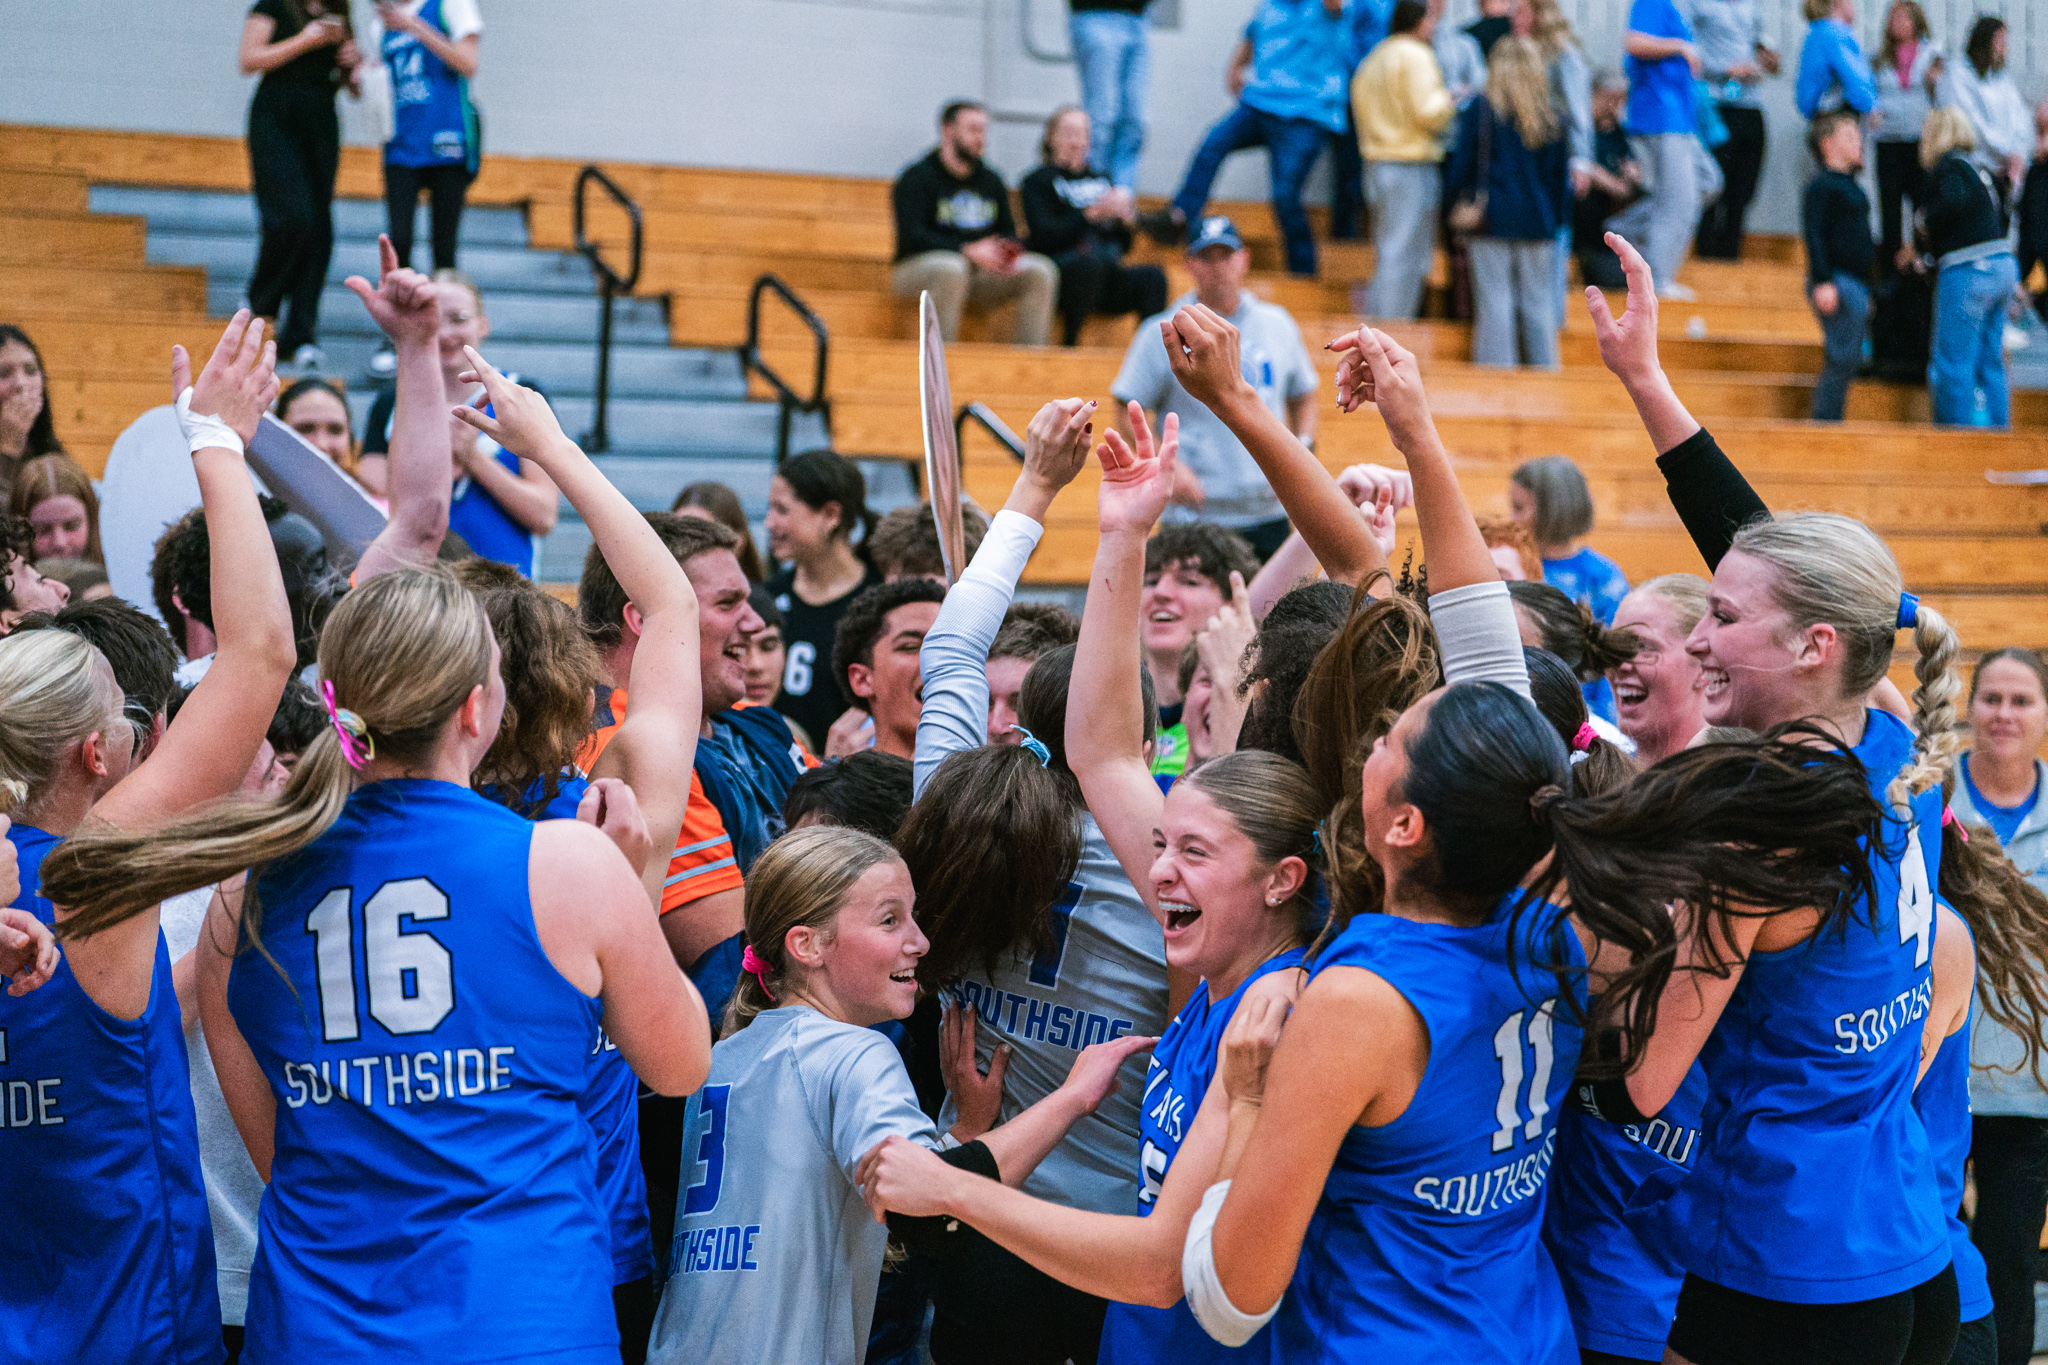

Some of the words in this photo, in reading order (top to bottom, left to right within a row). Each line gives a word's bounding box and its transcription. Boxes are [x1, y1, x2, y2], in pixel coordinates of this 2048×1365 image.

[784, 641, 816, 696] 6
[305, 876, 456, 1043] 16
[1898, 823, 1933, 971] 4
[284, 1046, 515, 1109] SOUTHSIDE
[1493, 999, 1555, 1153] 11
[683, 1083, 733, 1218] 3
